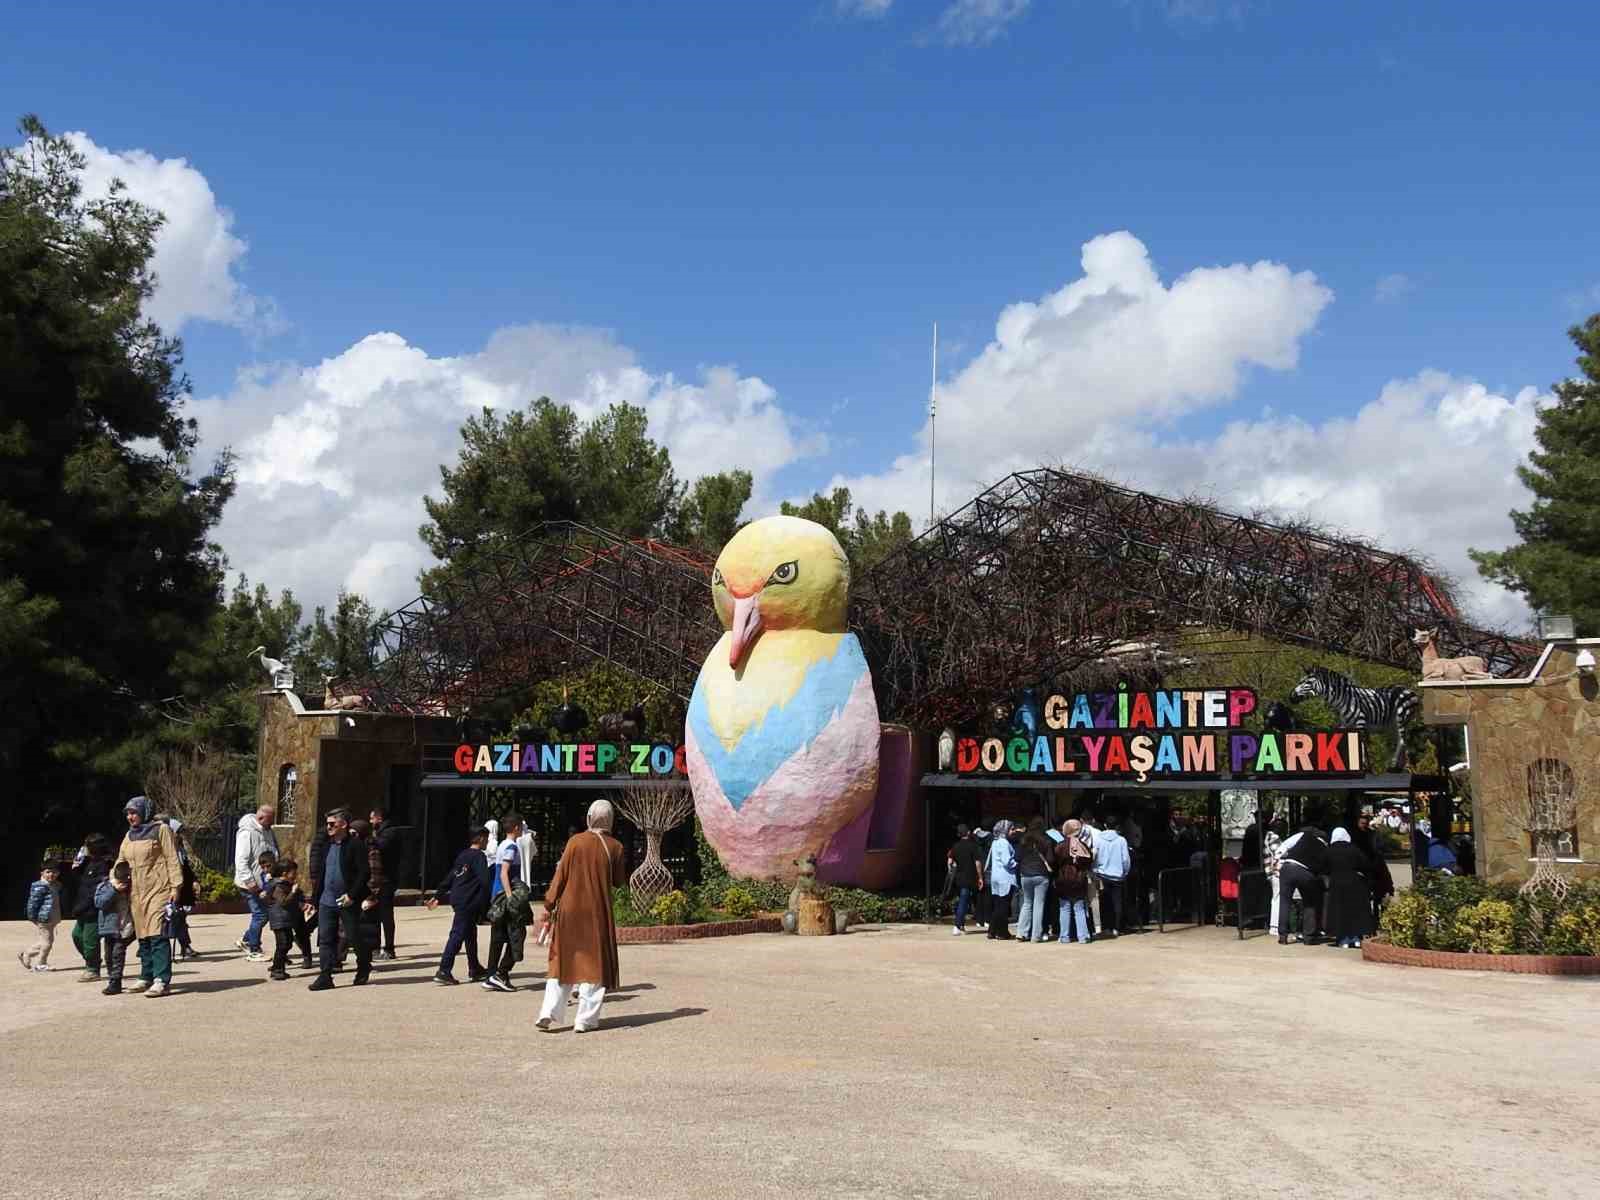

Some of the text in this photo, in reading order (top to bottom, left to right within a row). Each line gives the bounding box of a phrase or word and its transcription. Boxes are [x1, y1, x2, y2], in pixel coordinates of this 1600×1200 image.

[1044, 681, 1256, 730] GAZİANTEP
[957, 728, 1360, 782] DOĞAL YAŞAM PARKI
